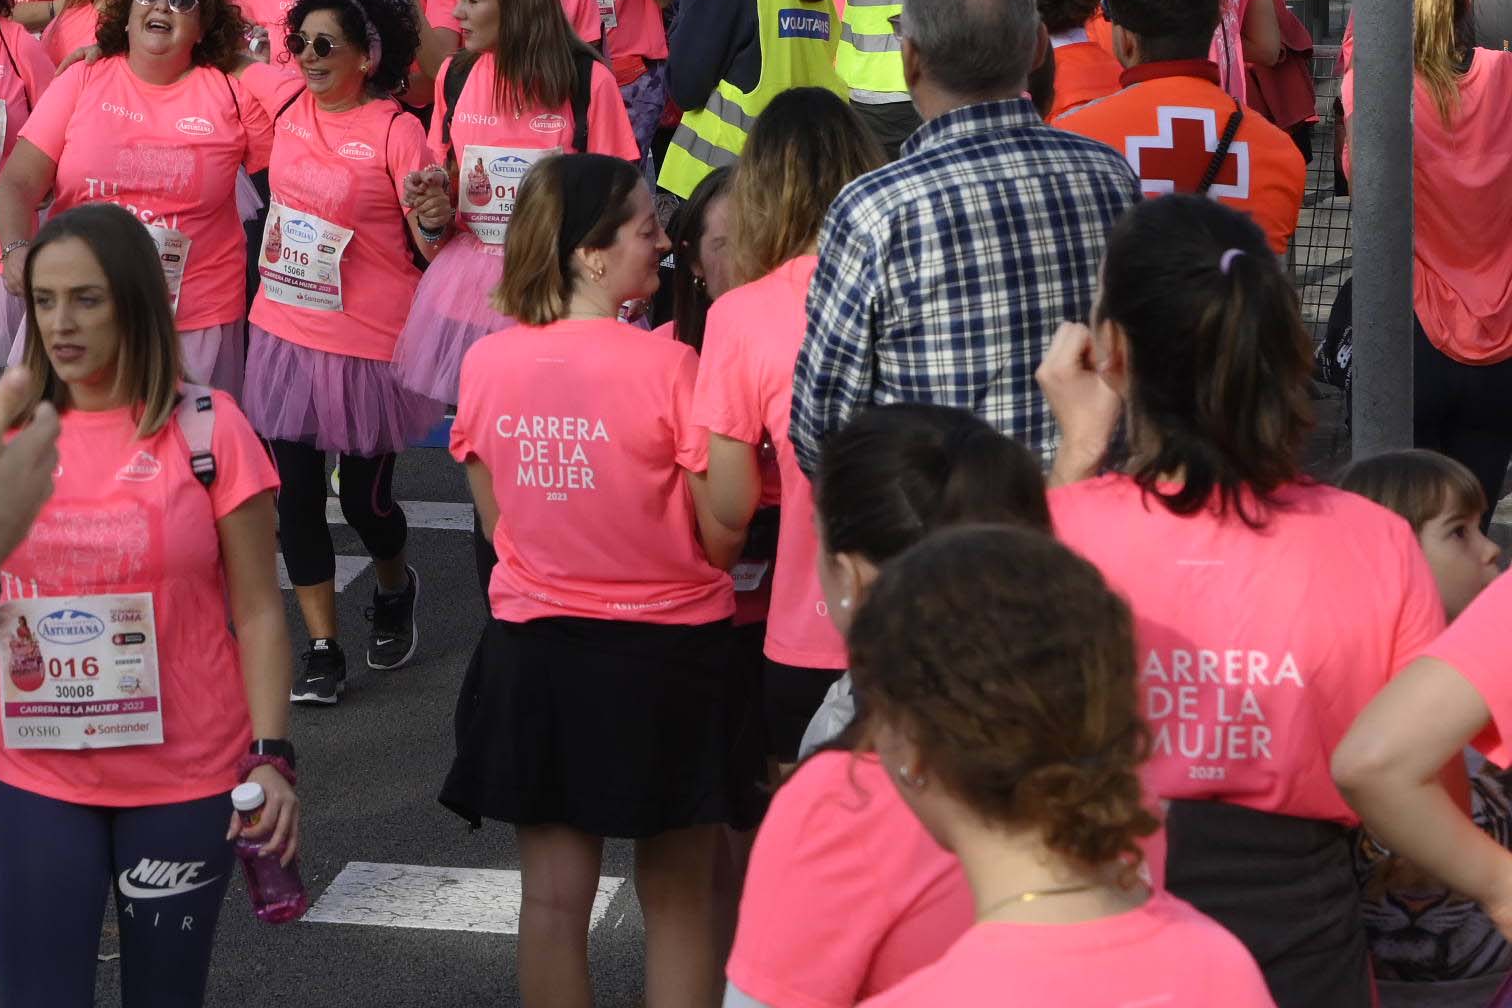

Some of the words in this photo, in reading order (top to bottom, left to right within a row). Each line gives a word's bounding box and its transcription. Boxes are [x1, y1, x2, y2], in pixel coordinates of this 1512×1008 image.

[101, 102, 144, 122] OYSHO
[459, 111, 498, 125] OYSHO
[282, 118, 312, 139] OYSHO
[86, 177, 118, 198] TU
[495, 185, 516, 199] 01
[283, 246, 309, 266] 016
[283, 264, 305, 277] 15068
[496, 414, 610, 442] CARRERA
[519, 439, 549, 463] DE
[558, 440, 589, 465] LA
[516, 466, 596, 490] MUJER
[546, 492, 568, 501] 2023
[110, 613, 143, 623] SUMA
[41, 623, 100, 637] ASTURIANA
[49, 656, 100, 678] 016
[1141, 649, 1305, 687] ARRERA
[55, 685, 94, 698] 30008
[19, 705, 59, 714] CARRERA
[60, 705, 71, 714] DE
[72, 705, 84, 714] LA
[85, 703, 120, 713] MUJER
[1146, 686, 1199, 720] DE
[1217, 689, 1266, 722] LA
[18, 721, 61, 737] OYSHO
[97, 722, 149, 736] Santander
[1151, 725, 1272, 760] MUJER
[129, 858, 206, 888] NIKE
